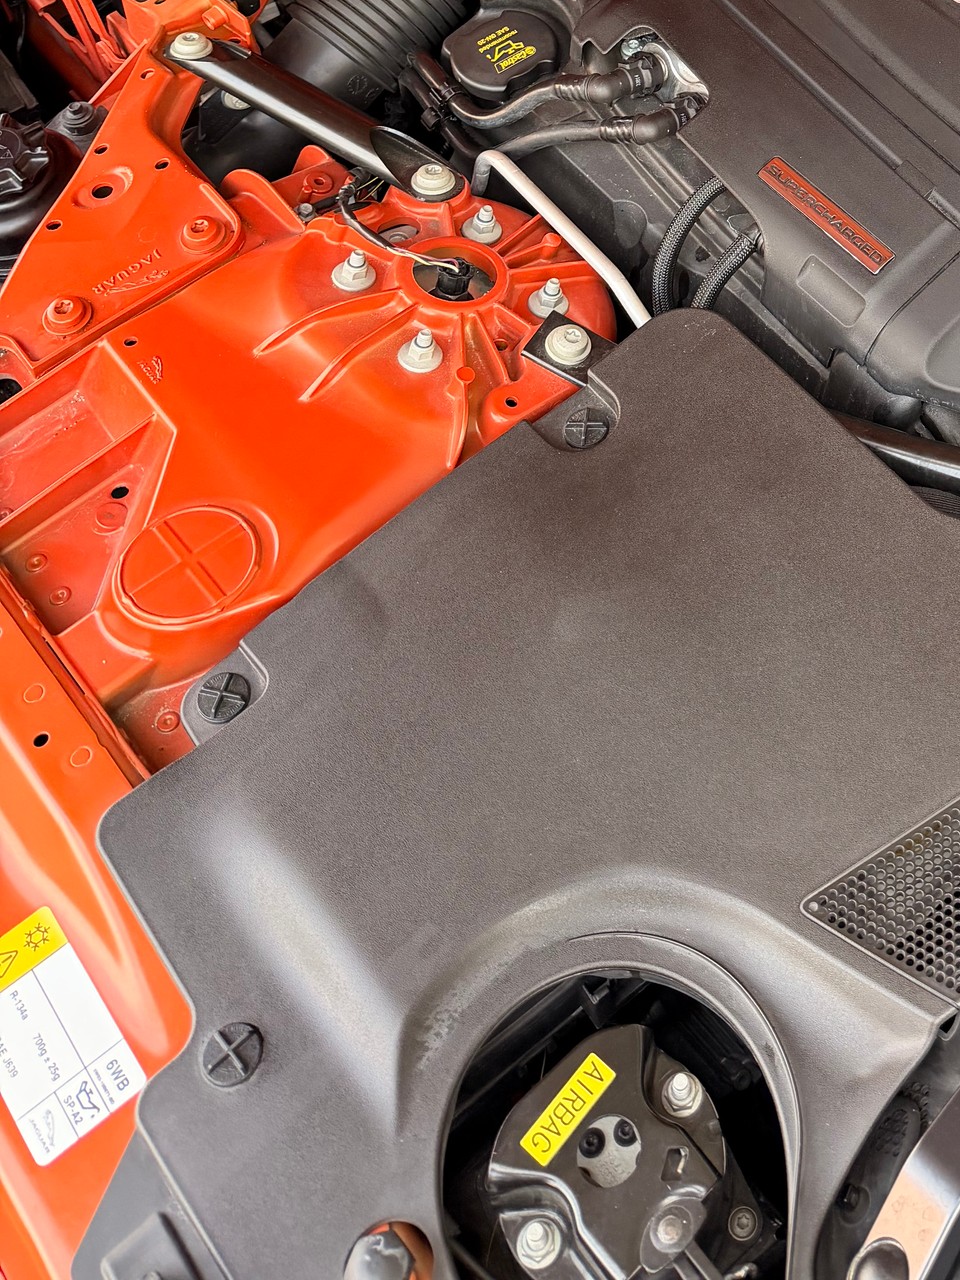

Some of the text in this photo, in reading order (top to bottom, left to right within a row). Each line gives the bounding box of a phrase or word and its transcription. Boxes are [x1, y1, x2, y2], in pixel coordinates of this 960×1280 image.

[479, 29, 518, 54] recommended
[499, 50, 527, 70] Castrol
[765, 164, 883, 264] SUPERCHARGED
[92, 248, 163, 295] JAGUAR
[9, 990, 29, 1021] R-134a
[33, 1032, 48, 1058] 700g
[48, 1063, 61, 1082] 25g
[3, 1057, 18, 1078] J639
[106, 1059, 130, 1092] 6WB
[63, 1094, 84, 1126] SP-A2
[531, 1060, 605, 1153] AIRBAG
[29, 1117, 50, 1154] JAGUAR
